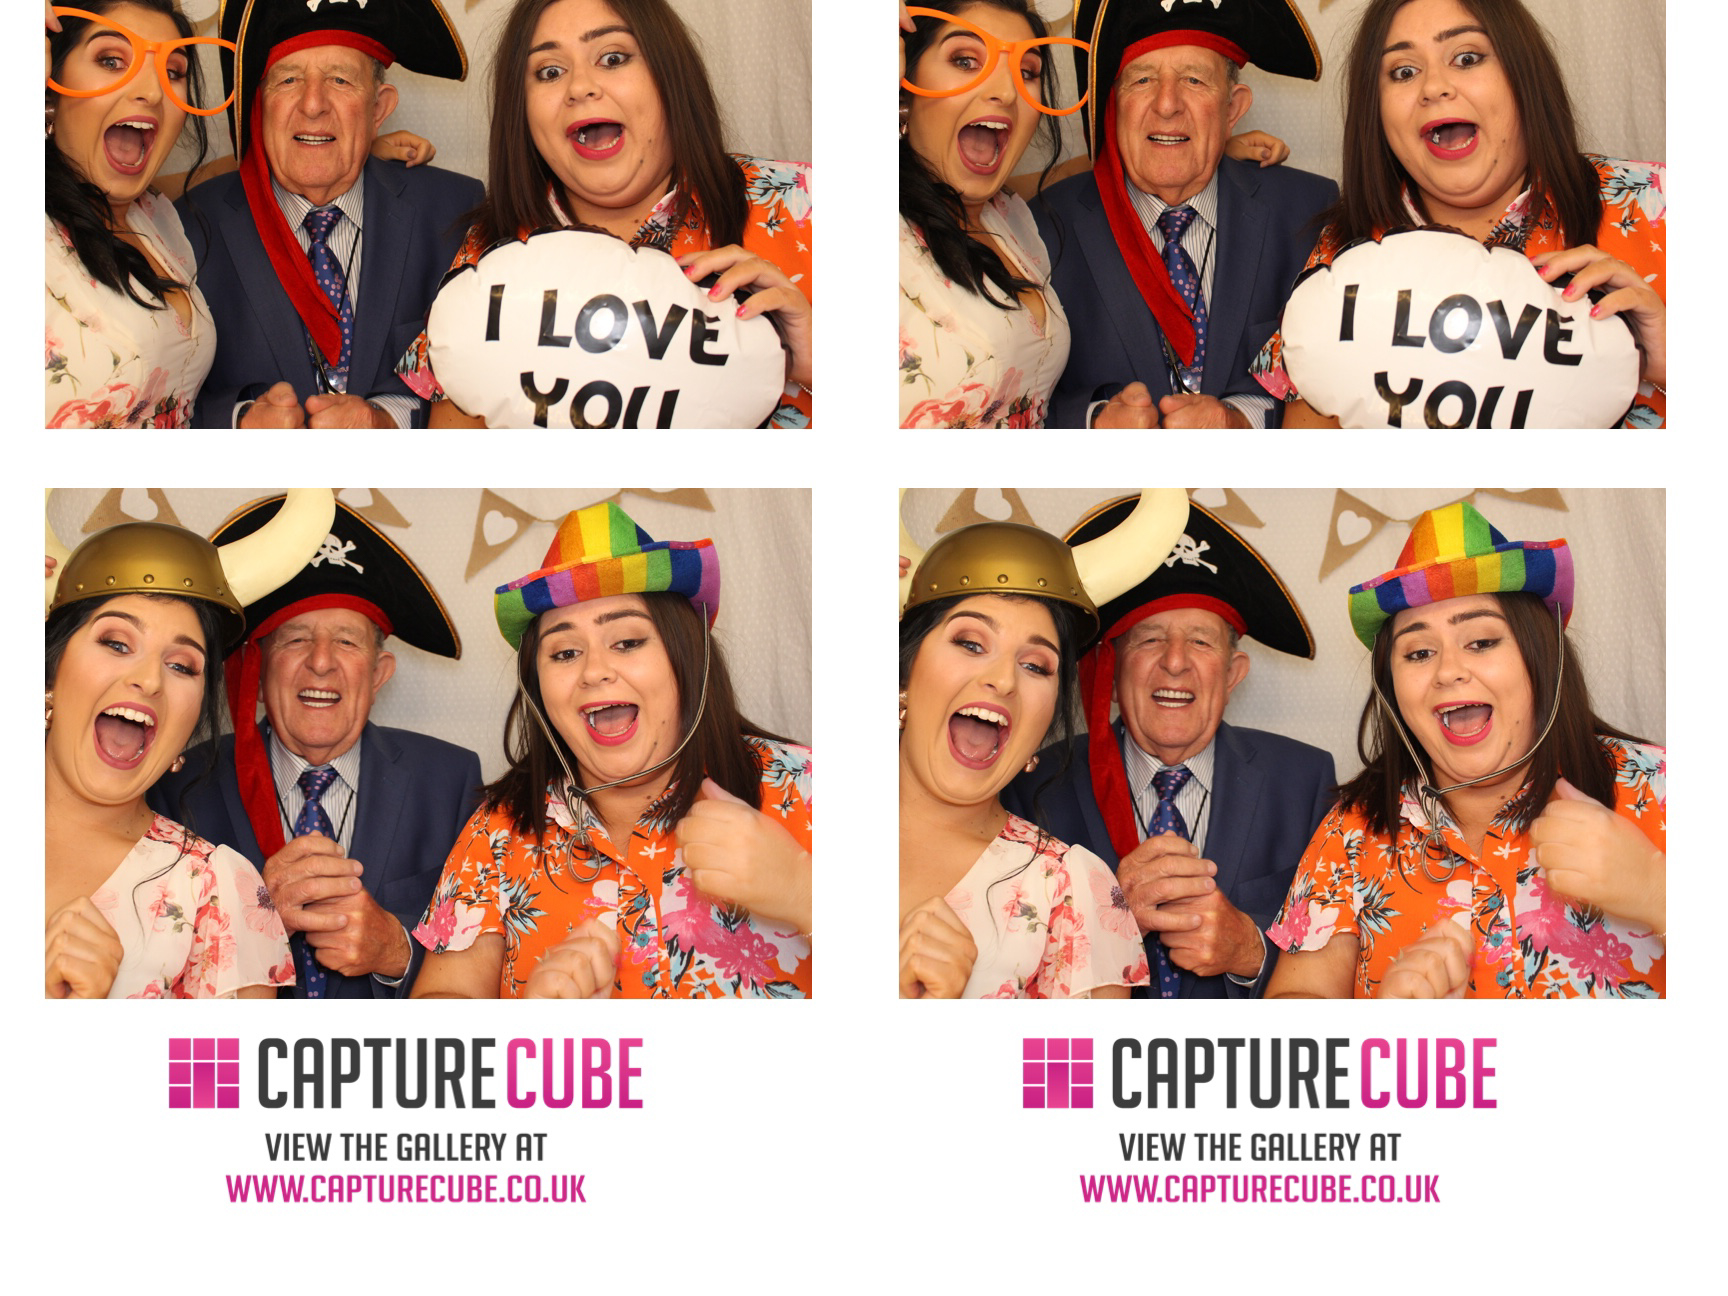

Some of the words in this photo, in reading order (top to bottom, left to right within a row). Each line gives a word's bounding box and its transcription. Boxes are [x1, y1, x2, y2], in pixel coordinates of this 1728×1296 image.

[485, 283, 506, 342] I
[537, 288, 729, 367] LOVE
[1339, 283, 1360, 342] I
[1391, 288, 1583, 367] LOVE
[519, 370, 681, 430] YOU
[1373, 370, 1535, 430] YOU
